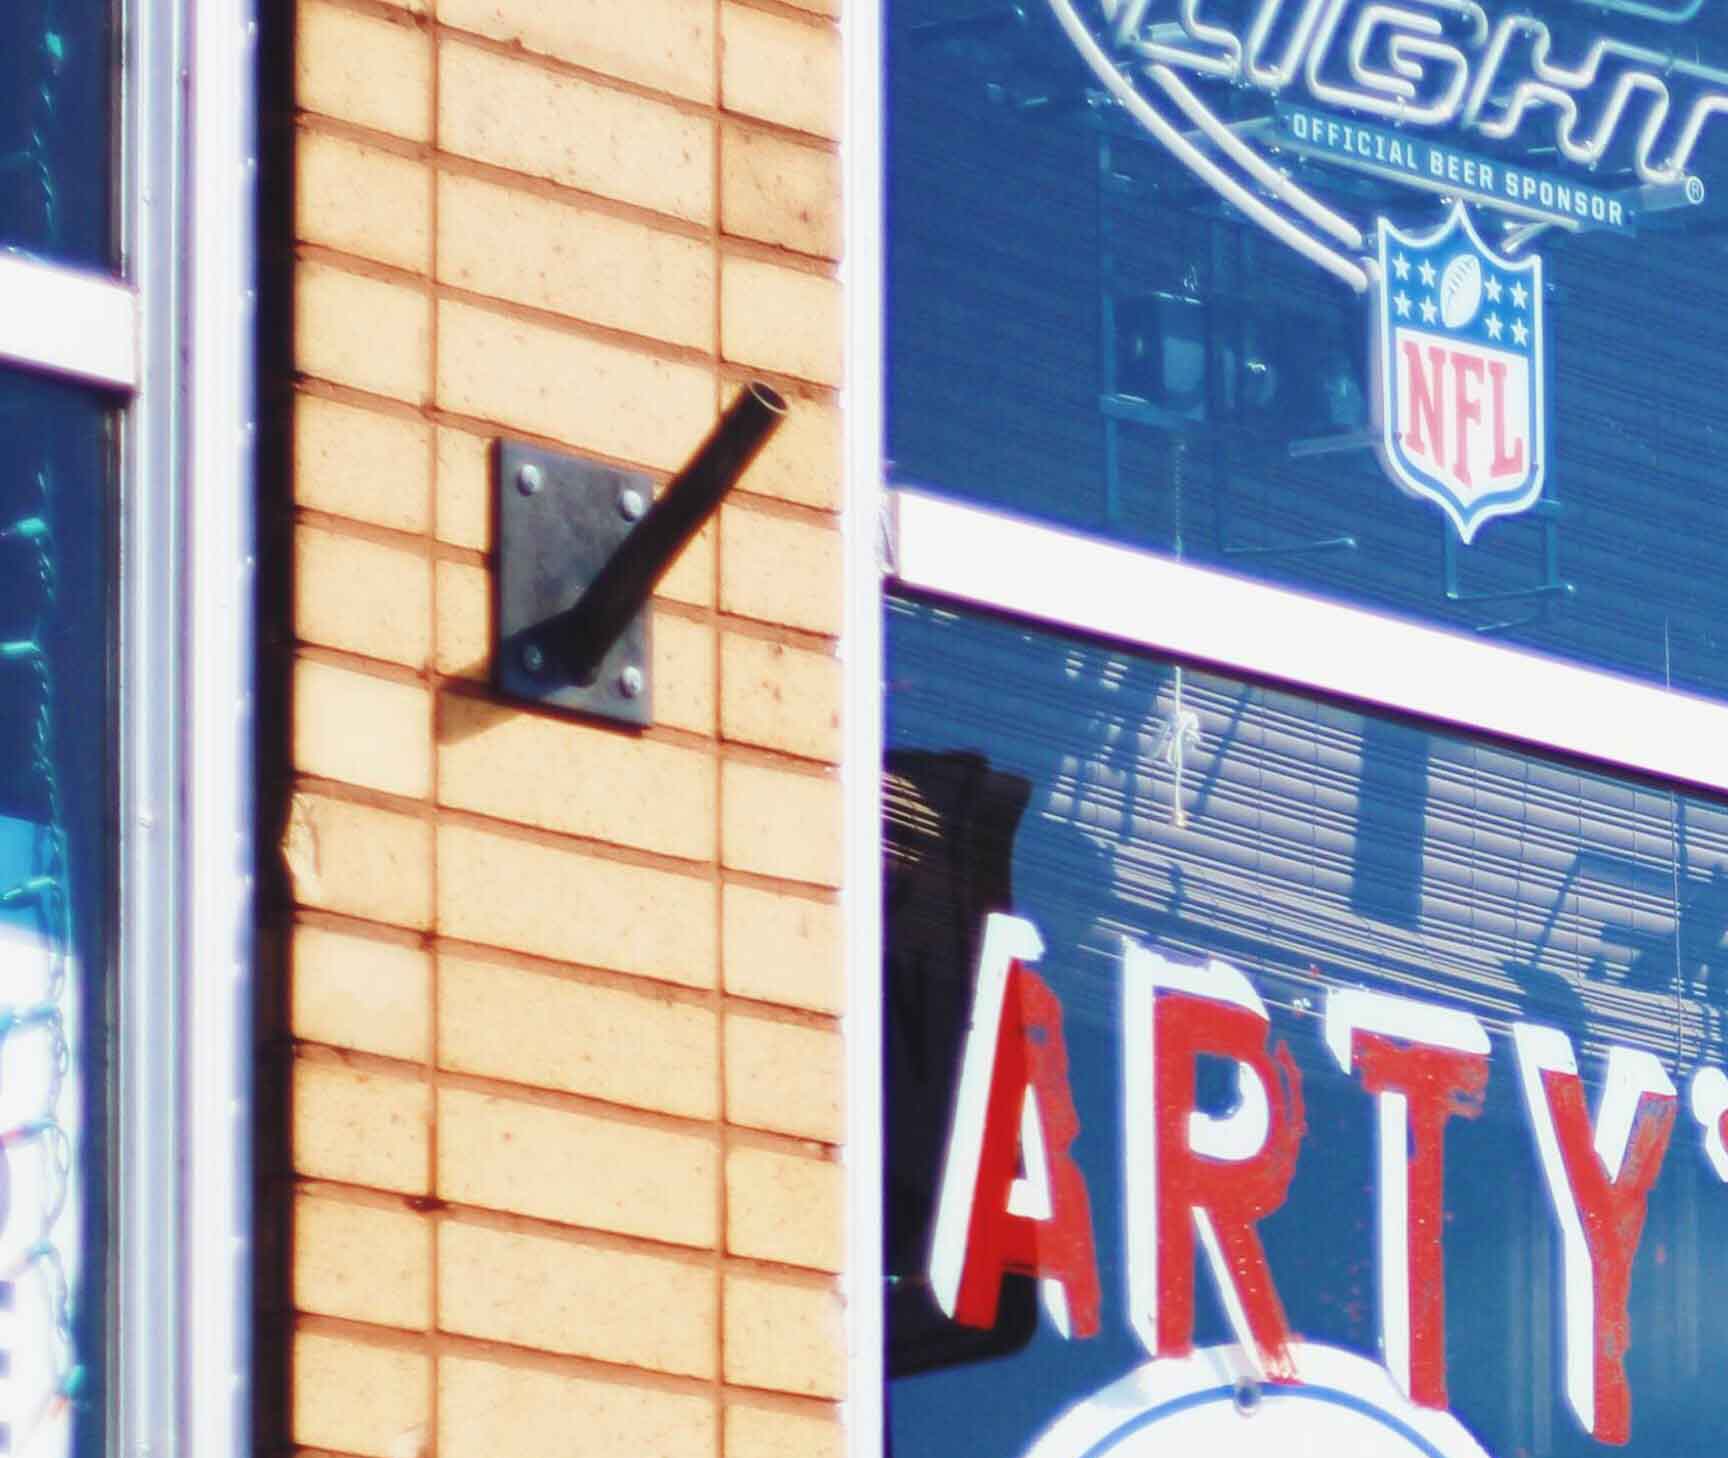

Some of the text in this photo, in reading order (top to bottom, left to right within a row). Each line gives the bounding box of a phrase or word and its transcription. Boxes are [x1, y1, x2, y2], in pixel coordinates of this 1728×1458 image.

[1291, 111, 1625, 227] OFFICIAL BEER SPONSOR
[1403, 338, 1525, 489] NFL
